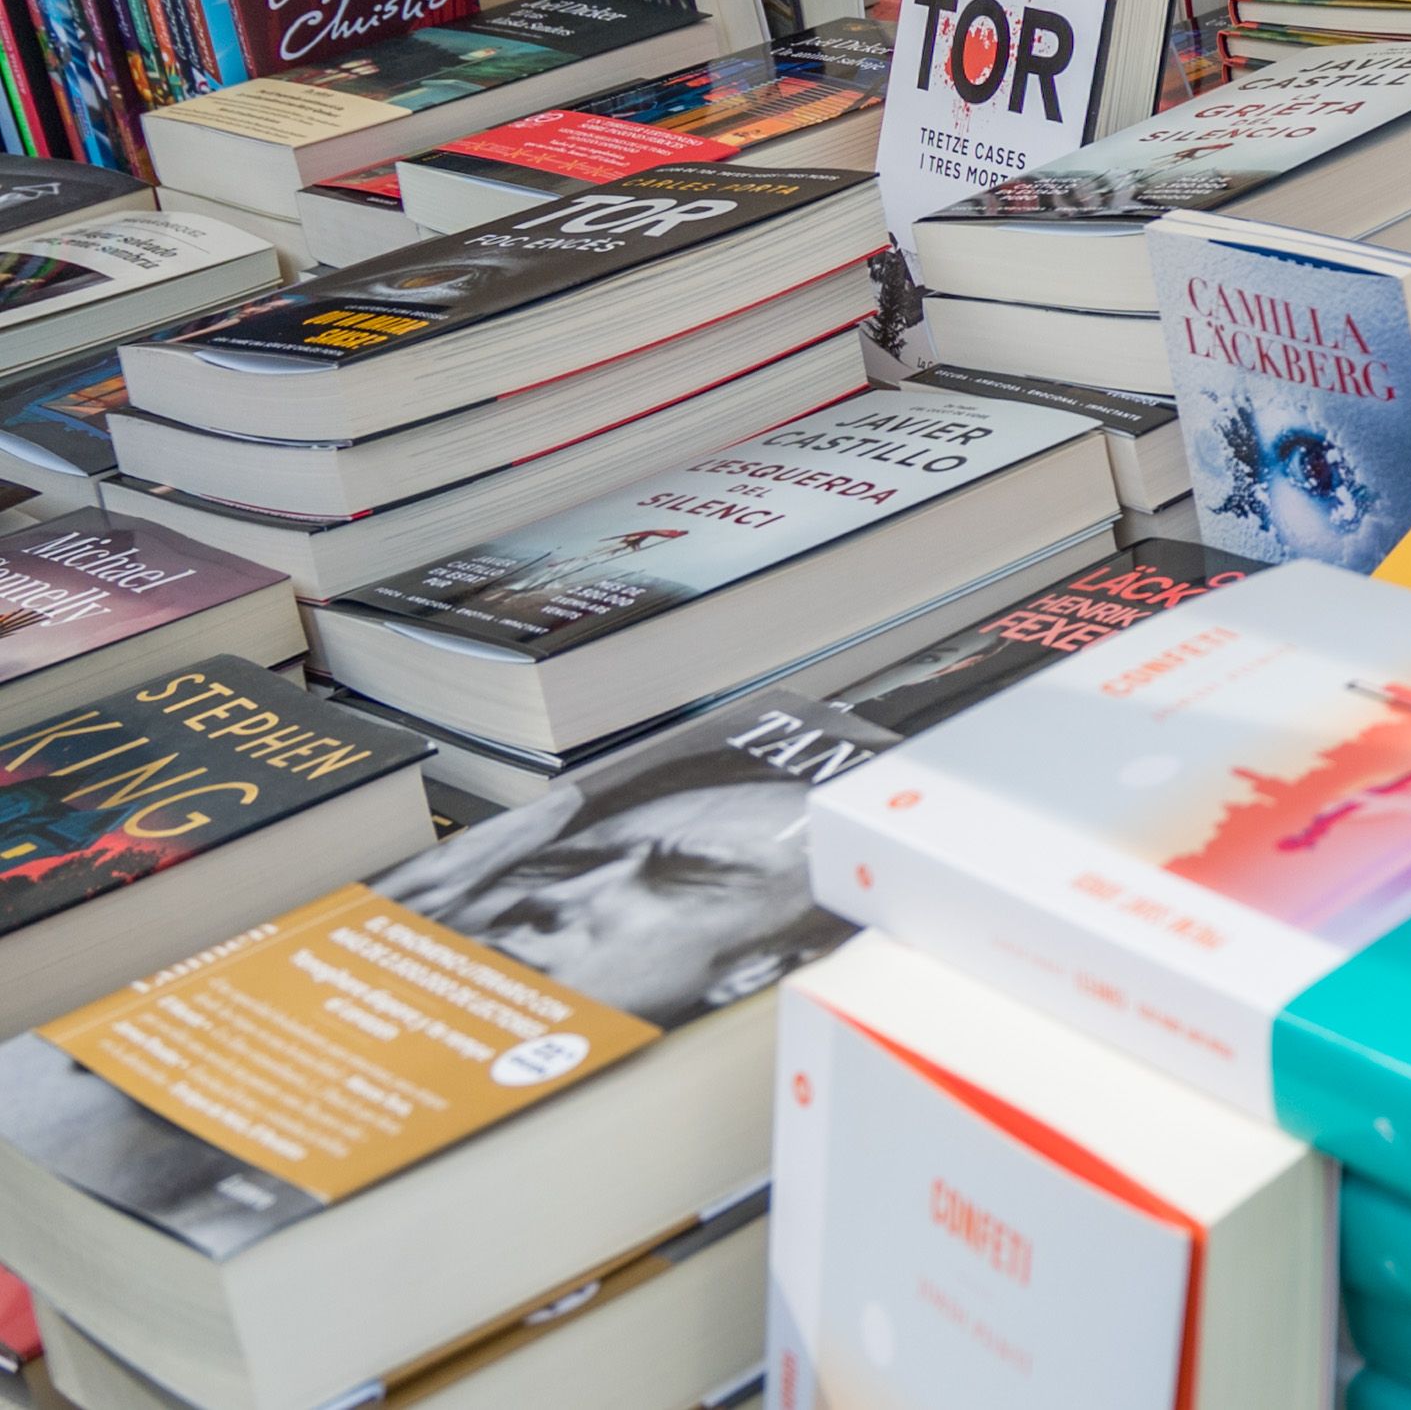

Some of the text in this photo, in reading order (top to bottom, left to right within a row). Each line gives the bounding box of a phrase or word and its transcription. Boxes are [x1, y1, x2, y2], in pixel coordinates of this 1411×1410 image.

[1194, 98, 1368, 120] GRIETA
[920, 127, 1027, 173] TRETZE CASES
[1138, 122, 1320, 144] SILENCIO
[926, 156, 962, 181] TRES
[514, 193, 740, 239] TOR
[463, 233, 522, 251] FOC
[1184, 274, 1372, 356] CAMILLA
[1184, 315, 1396, 403] LÄCKBERG
[835, 409, 994, 448] JAVIER
[760, 430, 971, 475] CASTILLO
[685, 457, 897, 507] L'ESQUERDA
[726, 483, 773, 500] DEL
[636, 490, 786, 531] SILENCI
[20, 529, 196, 597] Michael
[1025, 591, 1142, 627] HENRIK
[136, 671, 372, 783] STEPHEN
[3, 711, 261, 840] KING
